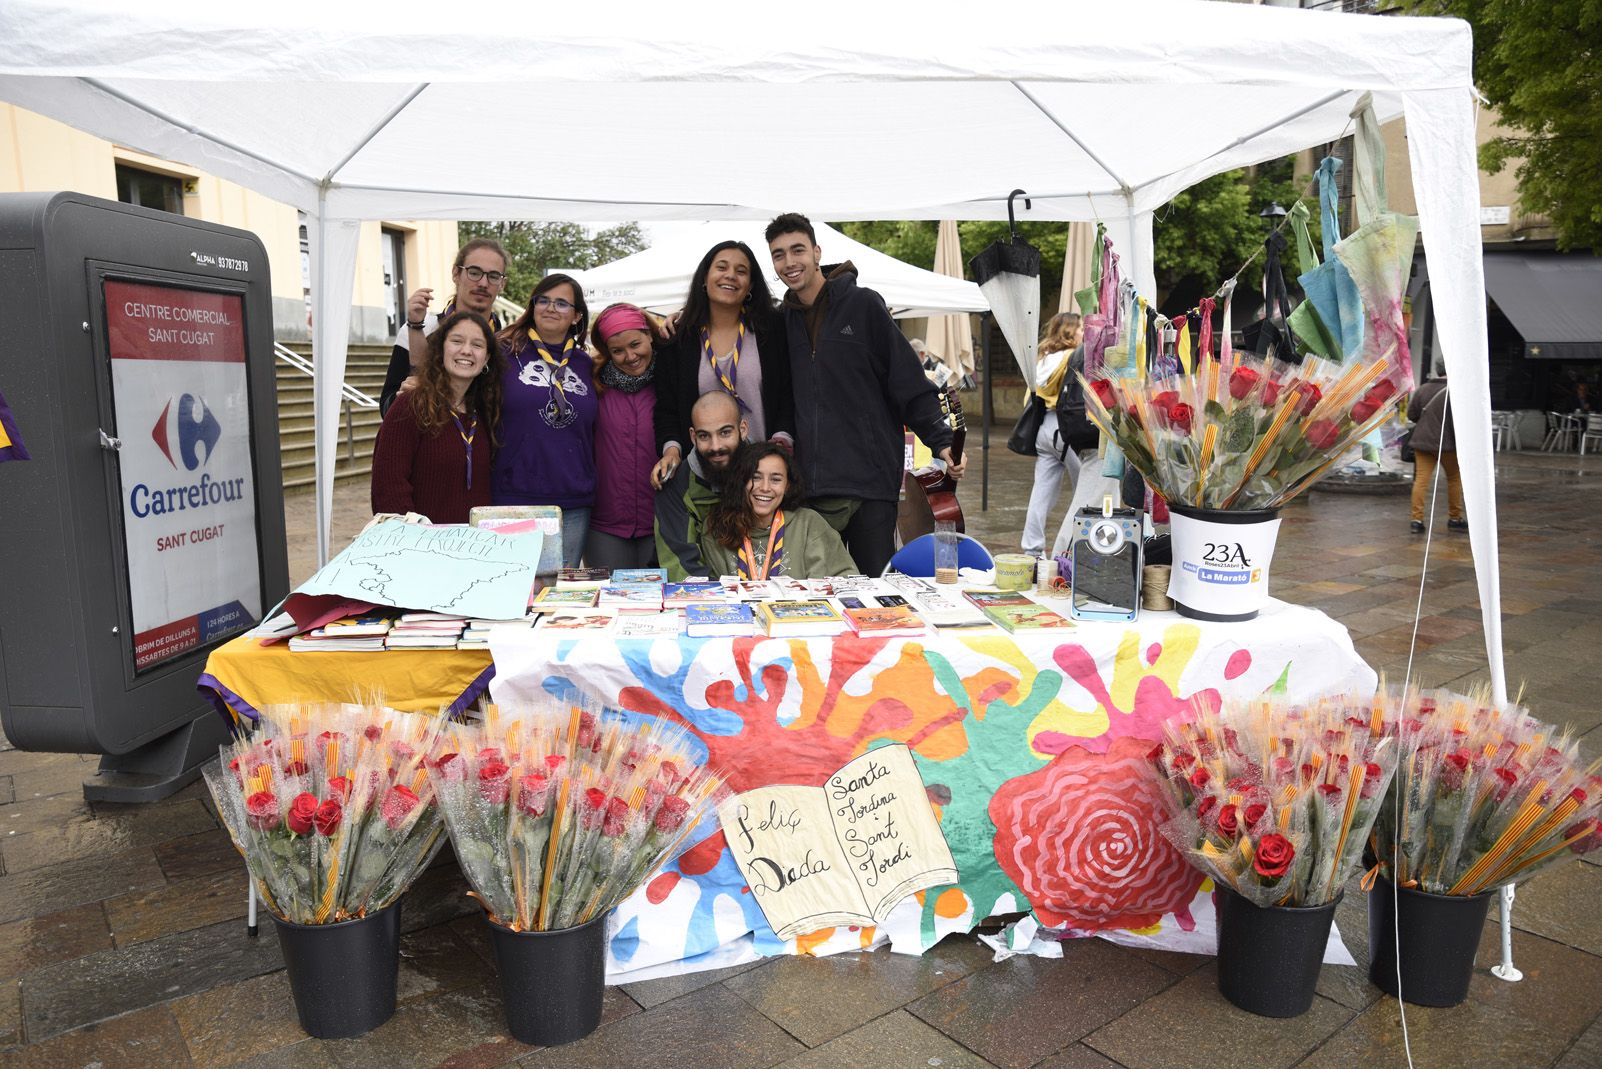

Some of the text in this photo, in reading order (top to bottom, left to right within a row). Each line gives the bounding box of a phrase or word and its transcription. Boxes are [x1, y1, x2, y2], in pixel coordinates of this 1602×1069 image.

[196, 254, 215, 264] ALPHA
[124, 301, 231, 326] CENTRE COMERCIAL
[148, 327, 215, 345] SANT CUGAT
[130, 473, 244, 518] Carrefour
[157, 524, 225, 552] SANT CUGAT
[1201, 571, 1213, 580] La
[1213, 573, 1248, 583] Marató
[217, 611, 235, 624] HORES
[155, 636, 165, 647] DE
[165, 627, 190, 643] DILLUNS
[831, 761, 891, 800] Santa
[837, 790, 898, 823] Jordina
[736, 799, 802, 854] Feliç
[845, 811, 899, 858] Sant
[859, 842, 912, 887] Jordi
